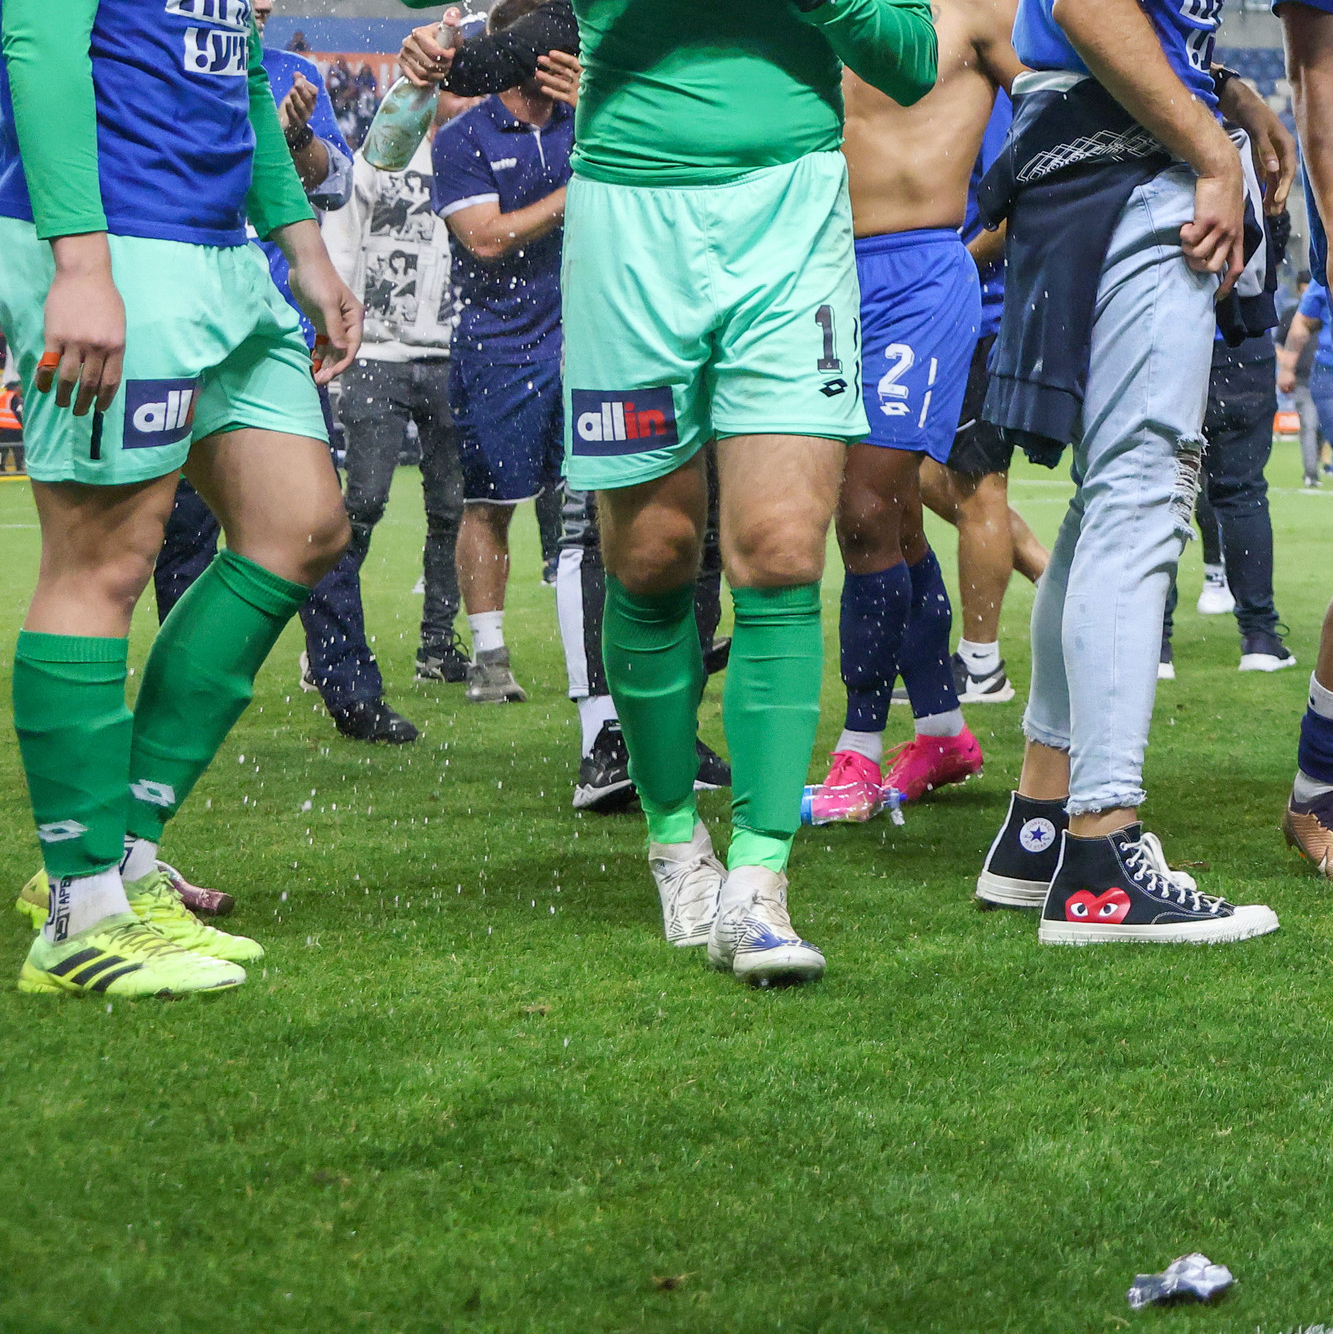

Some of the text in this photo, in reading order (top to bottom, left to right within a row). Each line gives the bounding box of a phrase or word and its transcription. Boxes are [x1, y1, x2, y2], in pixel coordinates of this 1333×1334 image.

[815, 304, 843, 374] 1
[877, 342, 916, 399] 2
[132, 389, 194, 433] all
